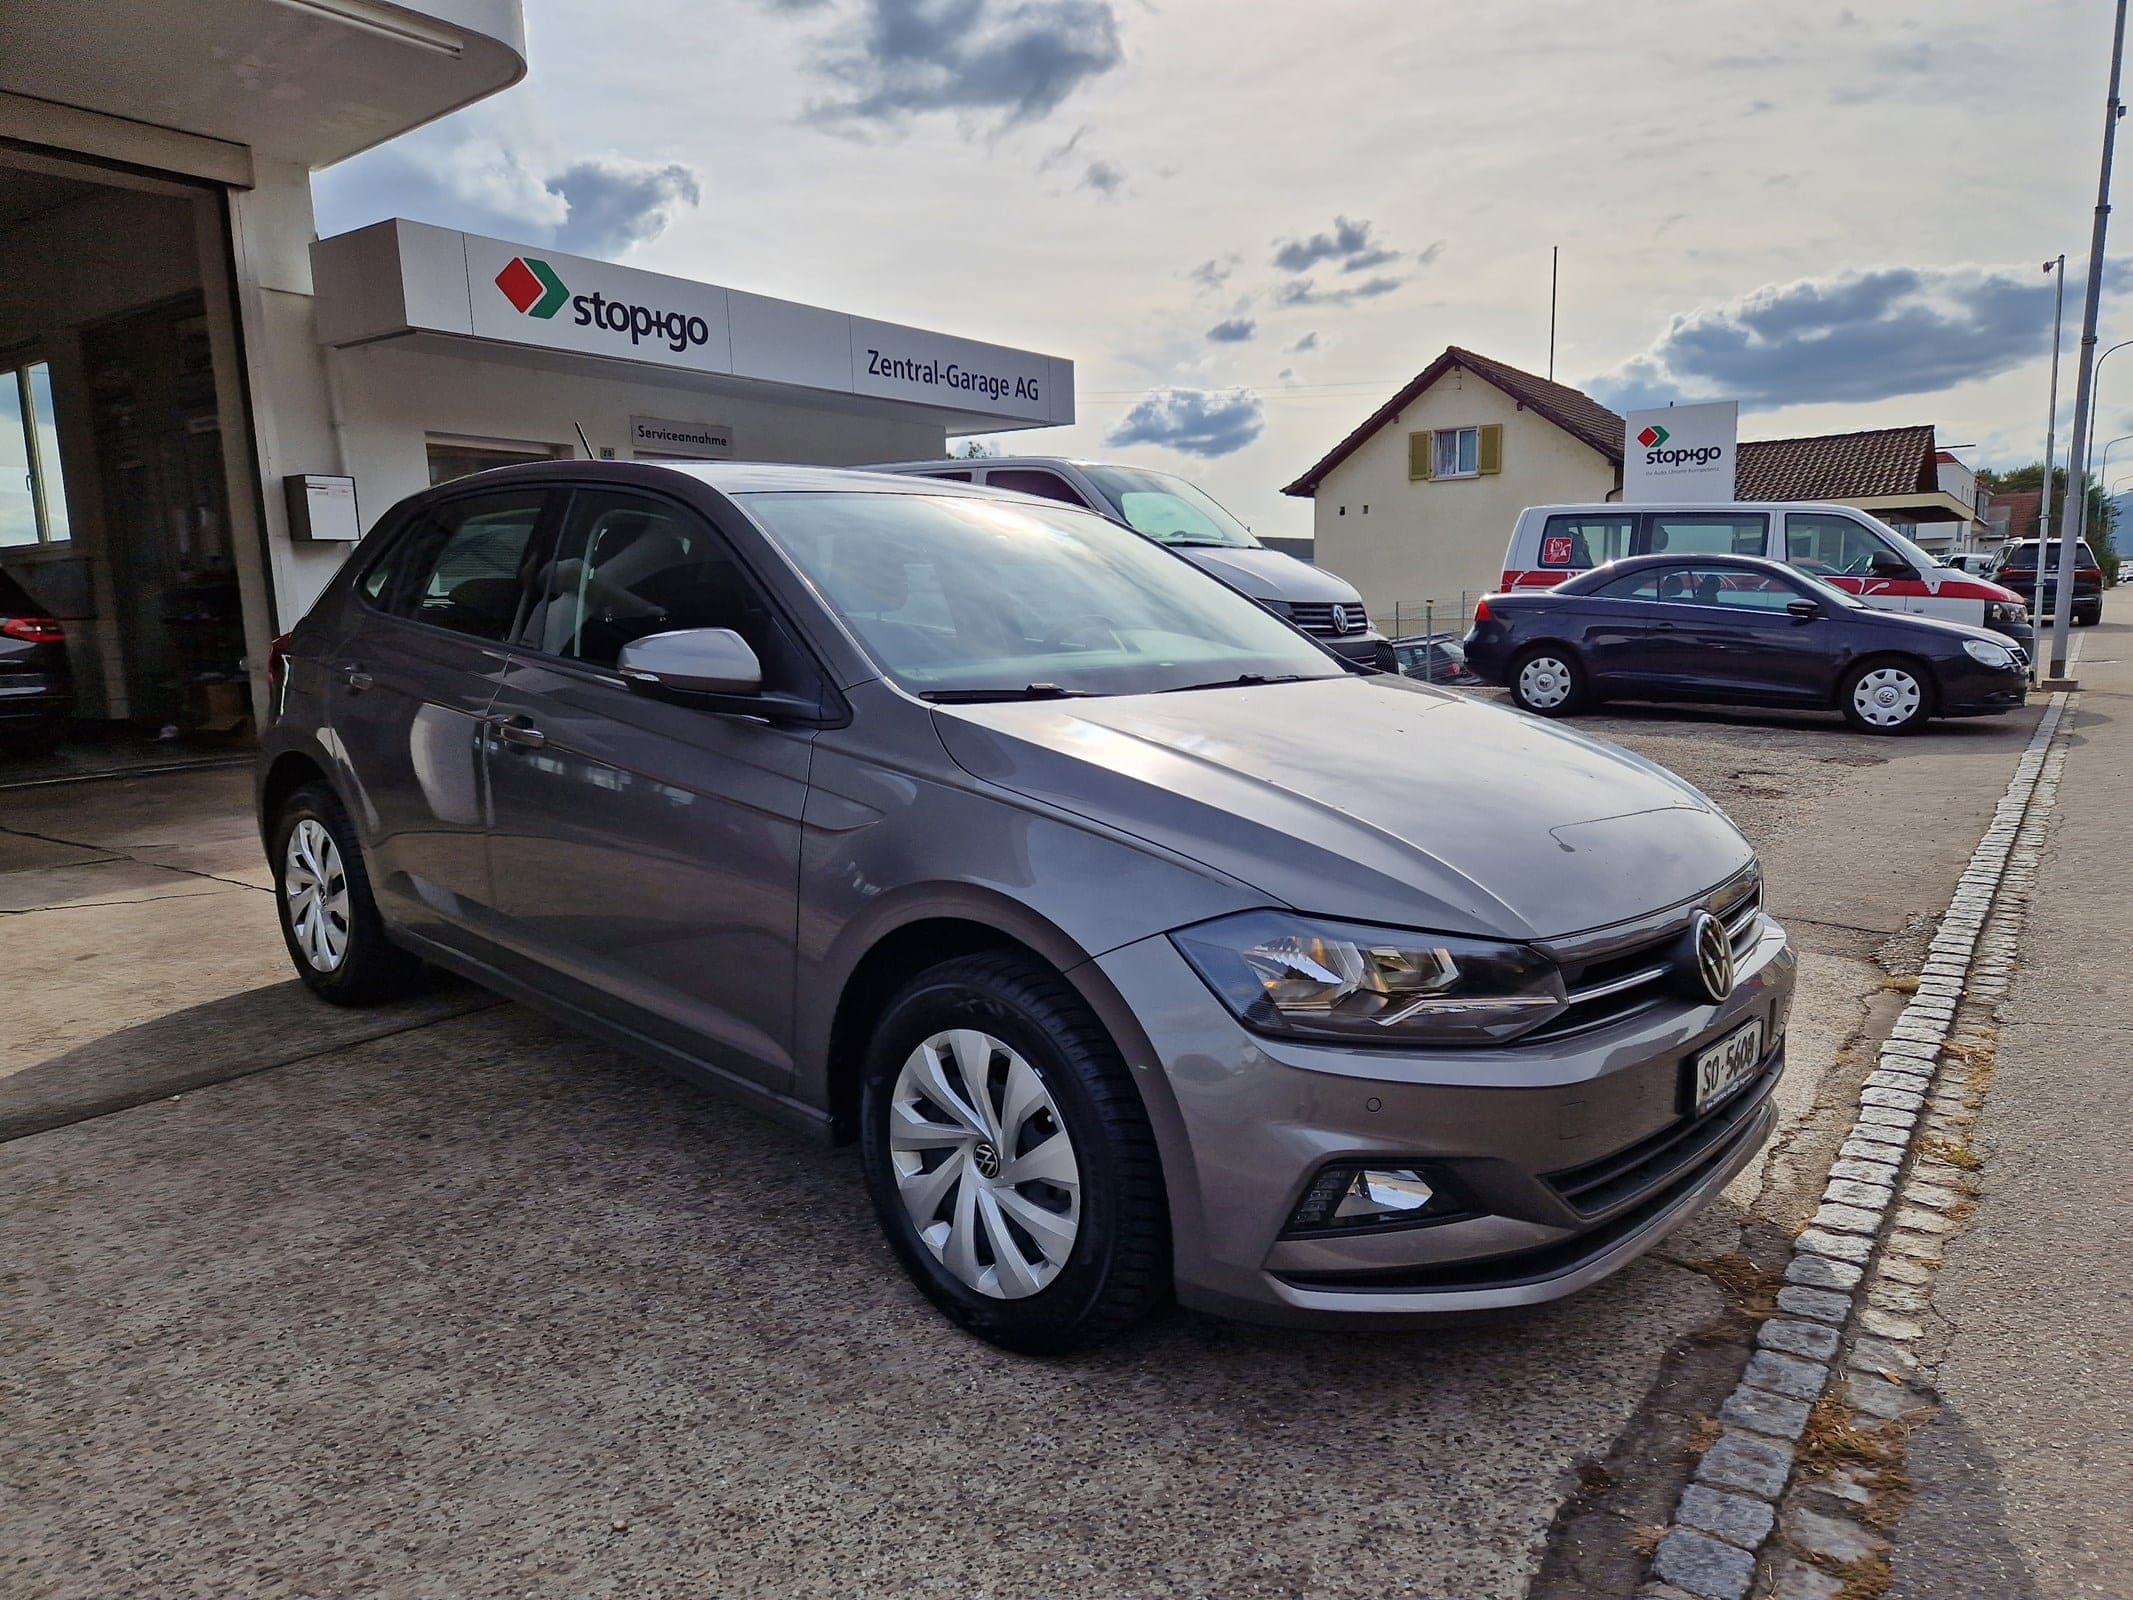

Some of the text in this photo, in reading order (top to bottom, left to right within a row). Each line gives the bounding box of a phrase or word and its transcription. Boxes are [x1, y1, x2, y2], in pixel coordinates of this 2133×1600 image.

[573, 291, 709, 352] stop+go
[867, 349, 1039, 401] Zentral-Garage AG
[637, 424, 728, 447] Serviceannahme
[1646, 446, 1722, 467] stop+go
